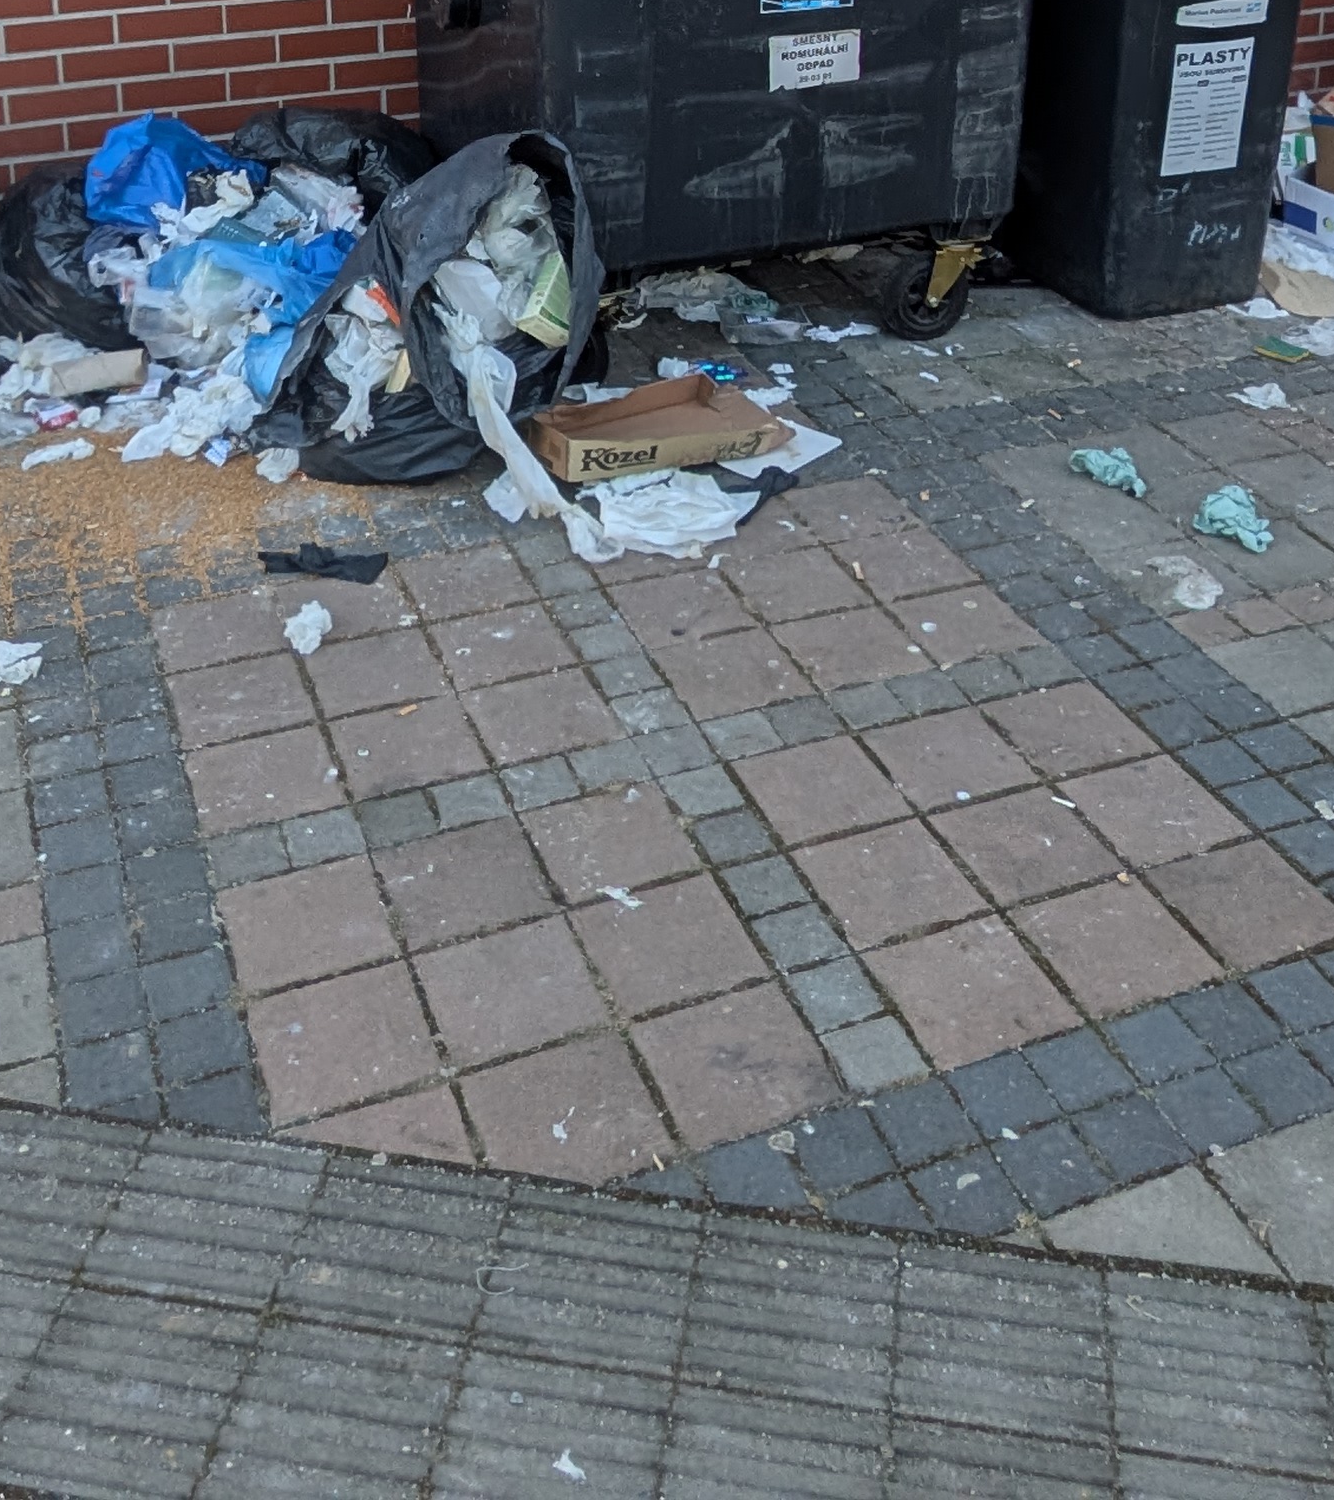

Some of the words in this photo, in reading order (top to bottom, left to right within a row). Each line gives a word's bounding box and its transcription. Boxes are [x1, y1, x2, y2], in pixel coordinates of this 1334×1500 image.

[797, 59, 834, 71] ODPAD
[1176, 46, 1251, 67] PLASTY
[580, 445, 658, 471] Kozel
